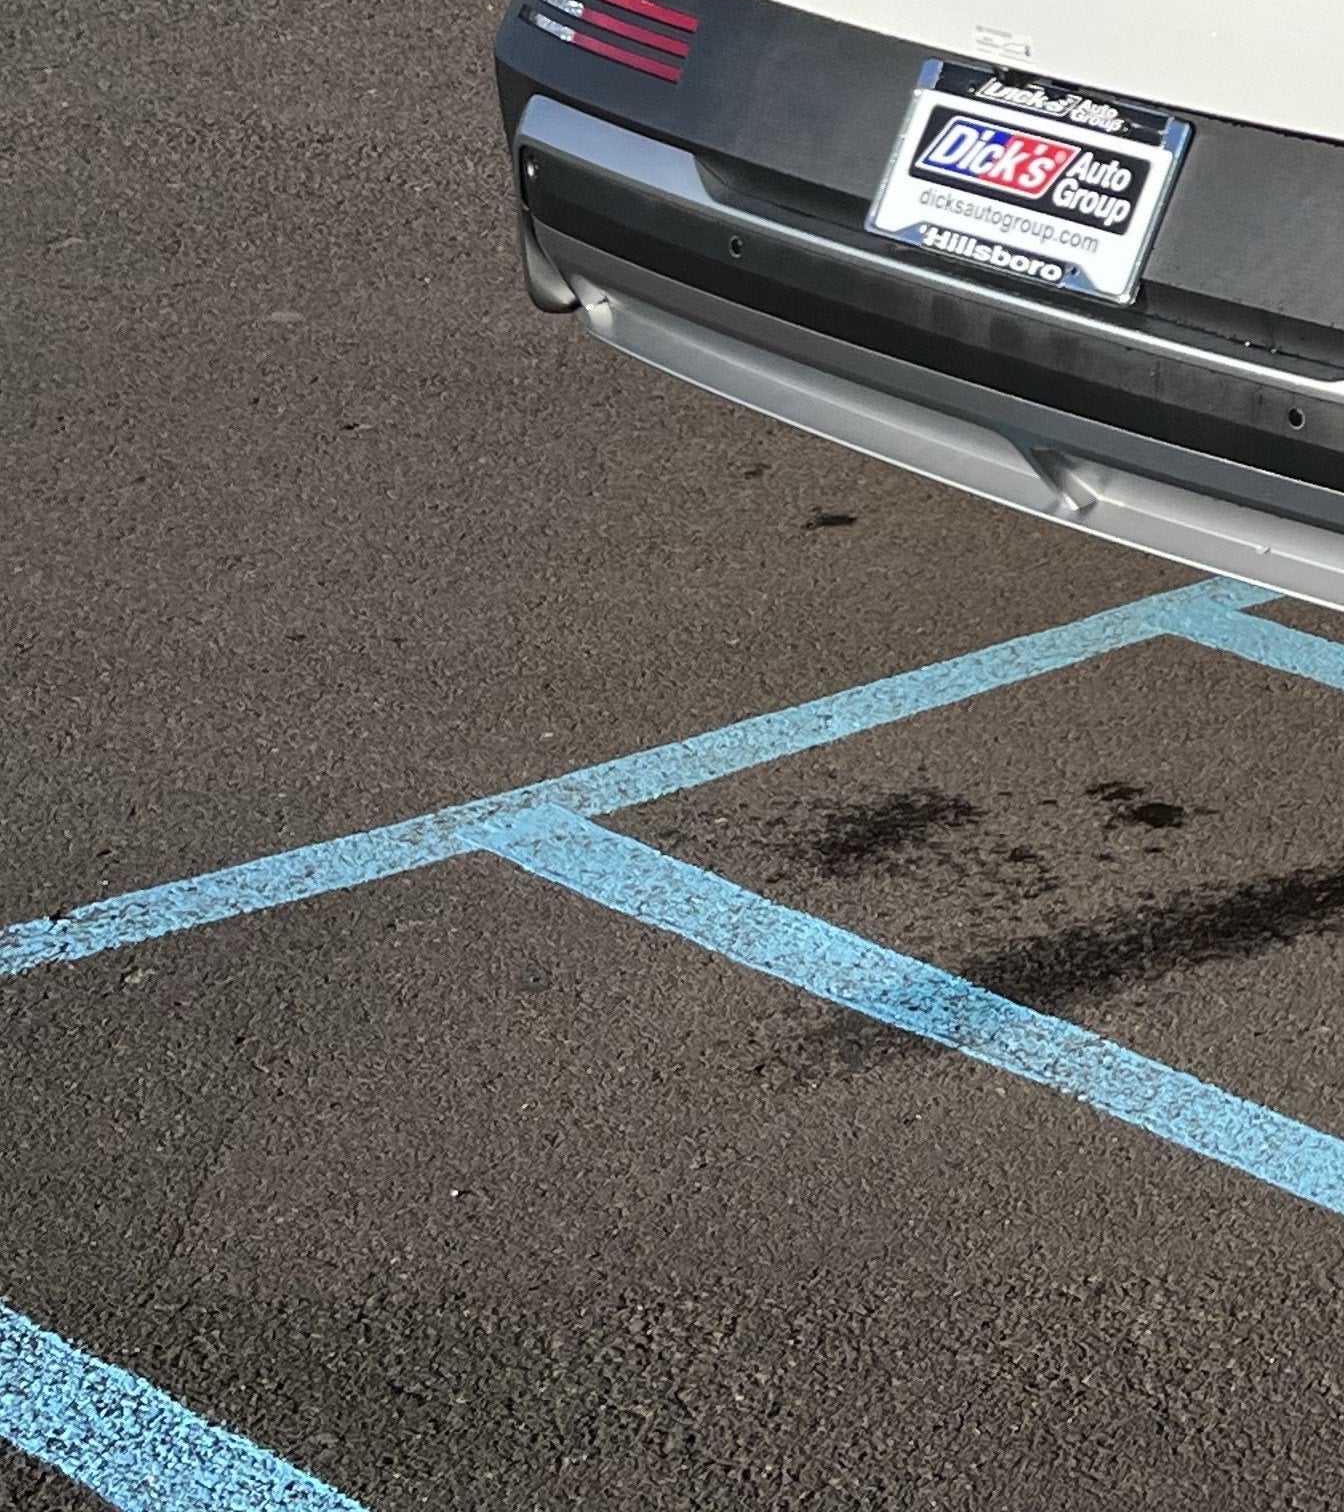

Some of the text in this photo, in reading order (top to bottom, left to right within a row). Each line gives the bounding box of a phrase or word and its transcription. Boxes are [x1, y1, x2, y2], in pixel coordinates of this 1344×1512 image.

[1066, 152, 1132, 191] Auto
[919, 185, 1099, 255] dicksautogroup.com
[1053, 178, 1132, 227] Group
[923, 224, 1062, 281] Hillsboro
